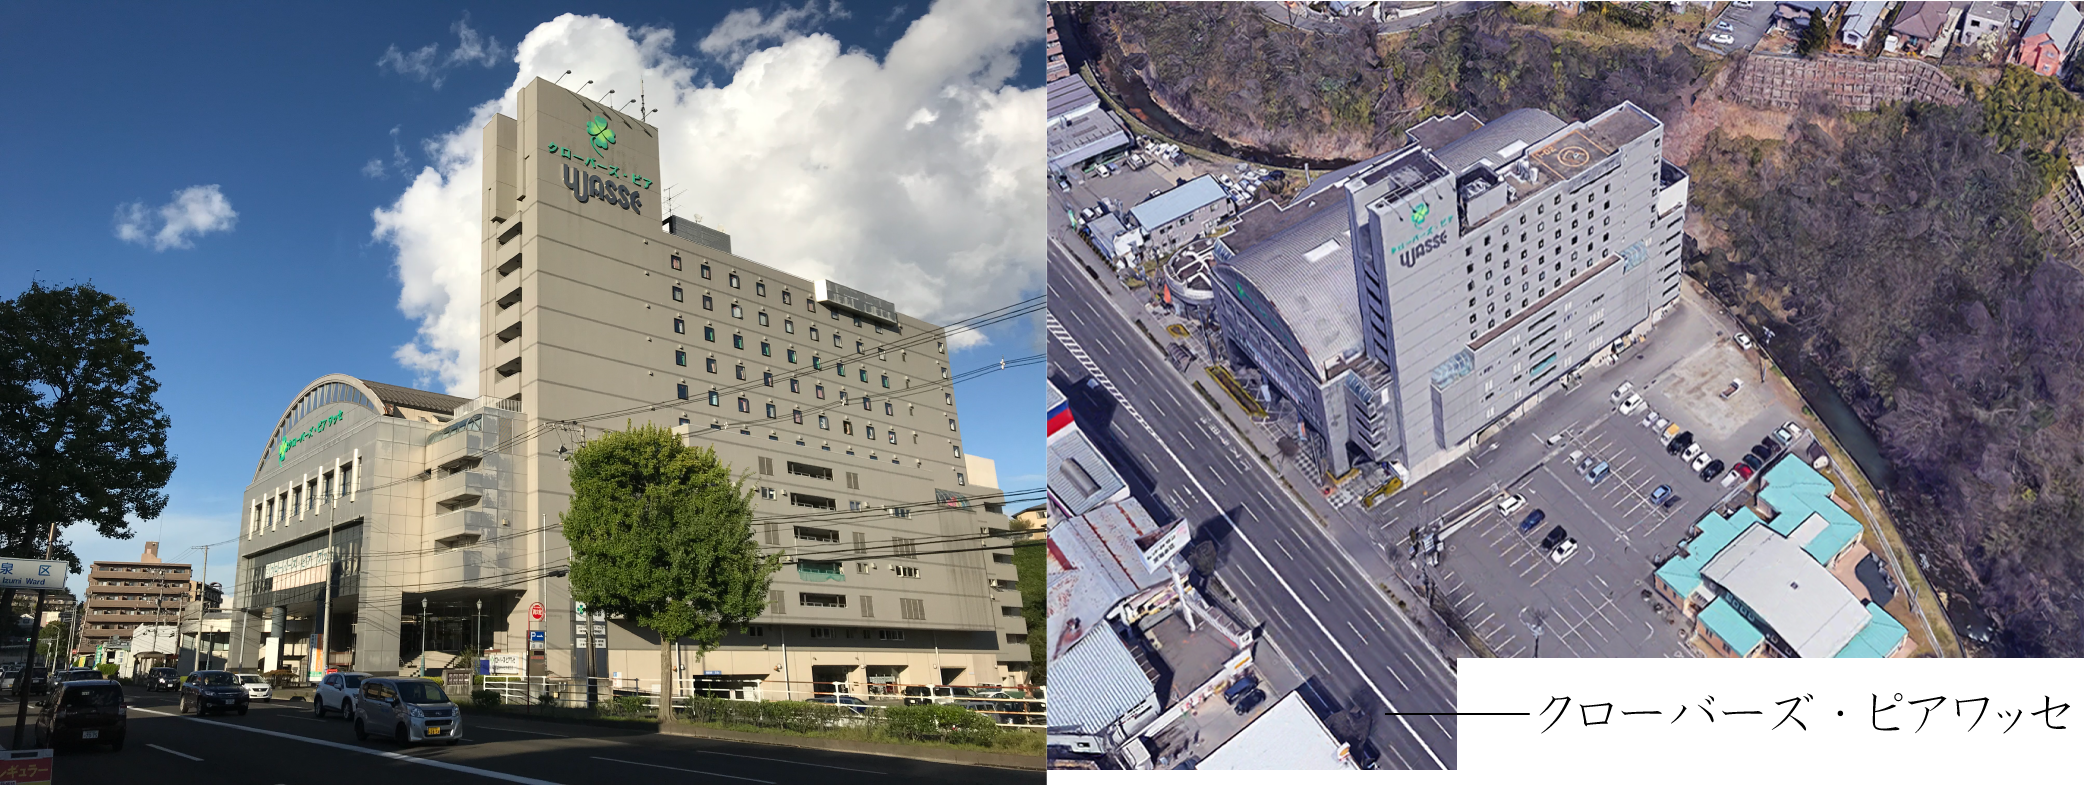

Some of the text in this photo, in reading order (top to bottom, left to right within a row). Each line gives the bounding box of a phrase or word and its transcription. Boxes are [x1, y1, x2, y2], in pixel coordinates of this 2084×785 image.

[548, 141, 653, 190] クローバーズ・ピア
